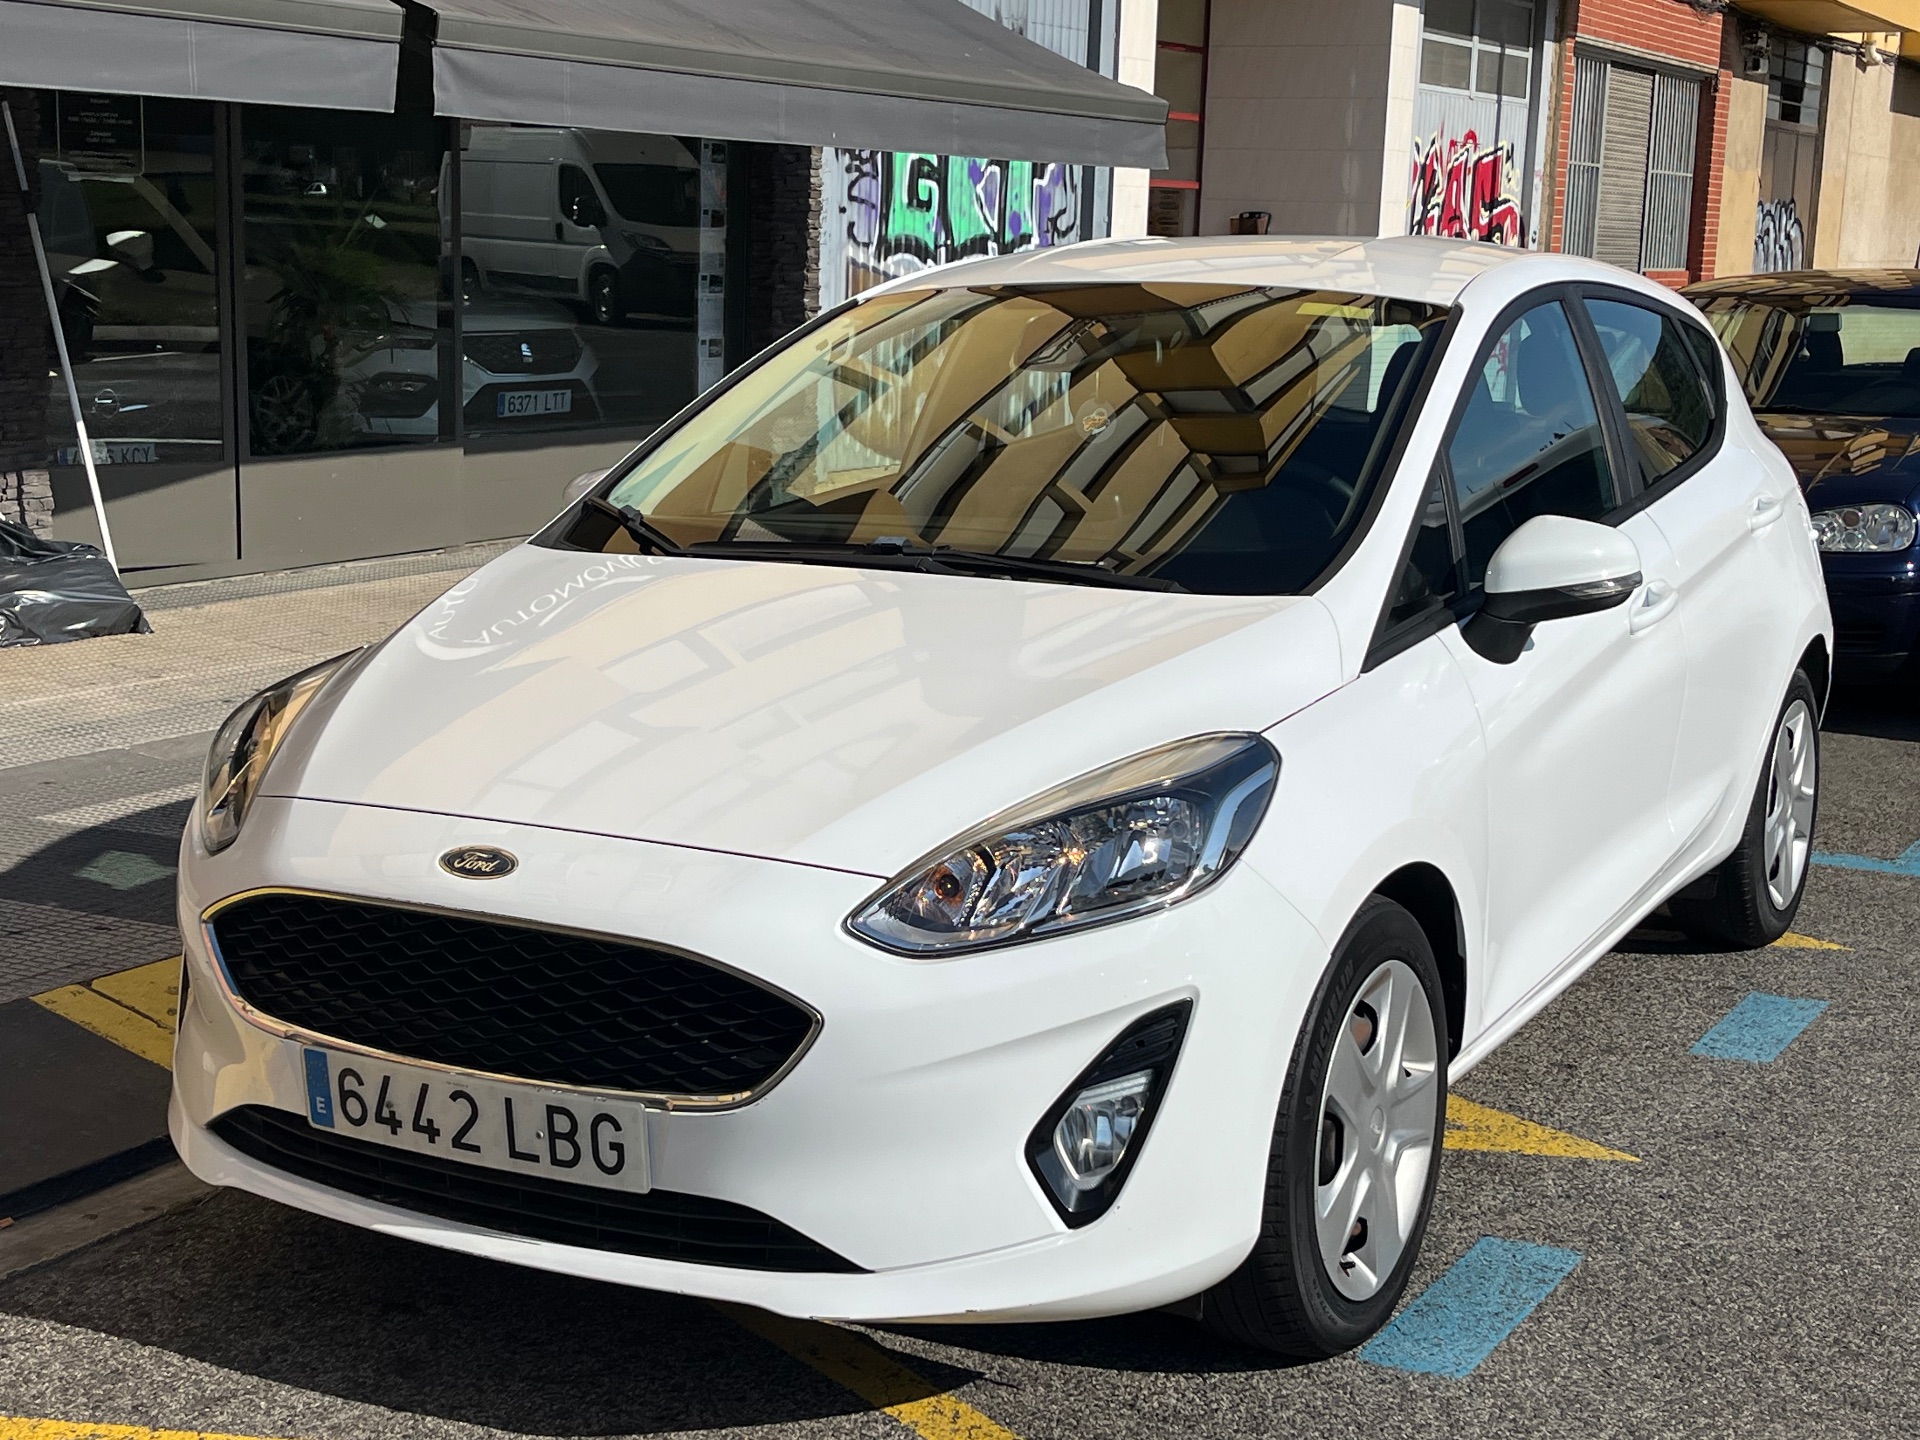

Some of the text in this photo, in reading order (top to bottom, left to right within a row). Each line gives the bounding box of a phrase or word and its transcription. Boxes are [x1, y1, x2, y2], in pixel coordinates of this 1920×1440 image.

[508, 392, 567, 413] 6371 LTT
[453, 851, 501, 873] Ford
[1310, 959, 1355, 1086] MICHELIN
[316, 1067, 627, 1177] E 6442 LBG
